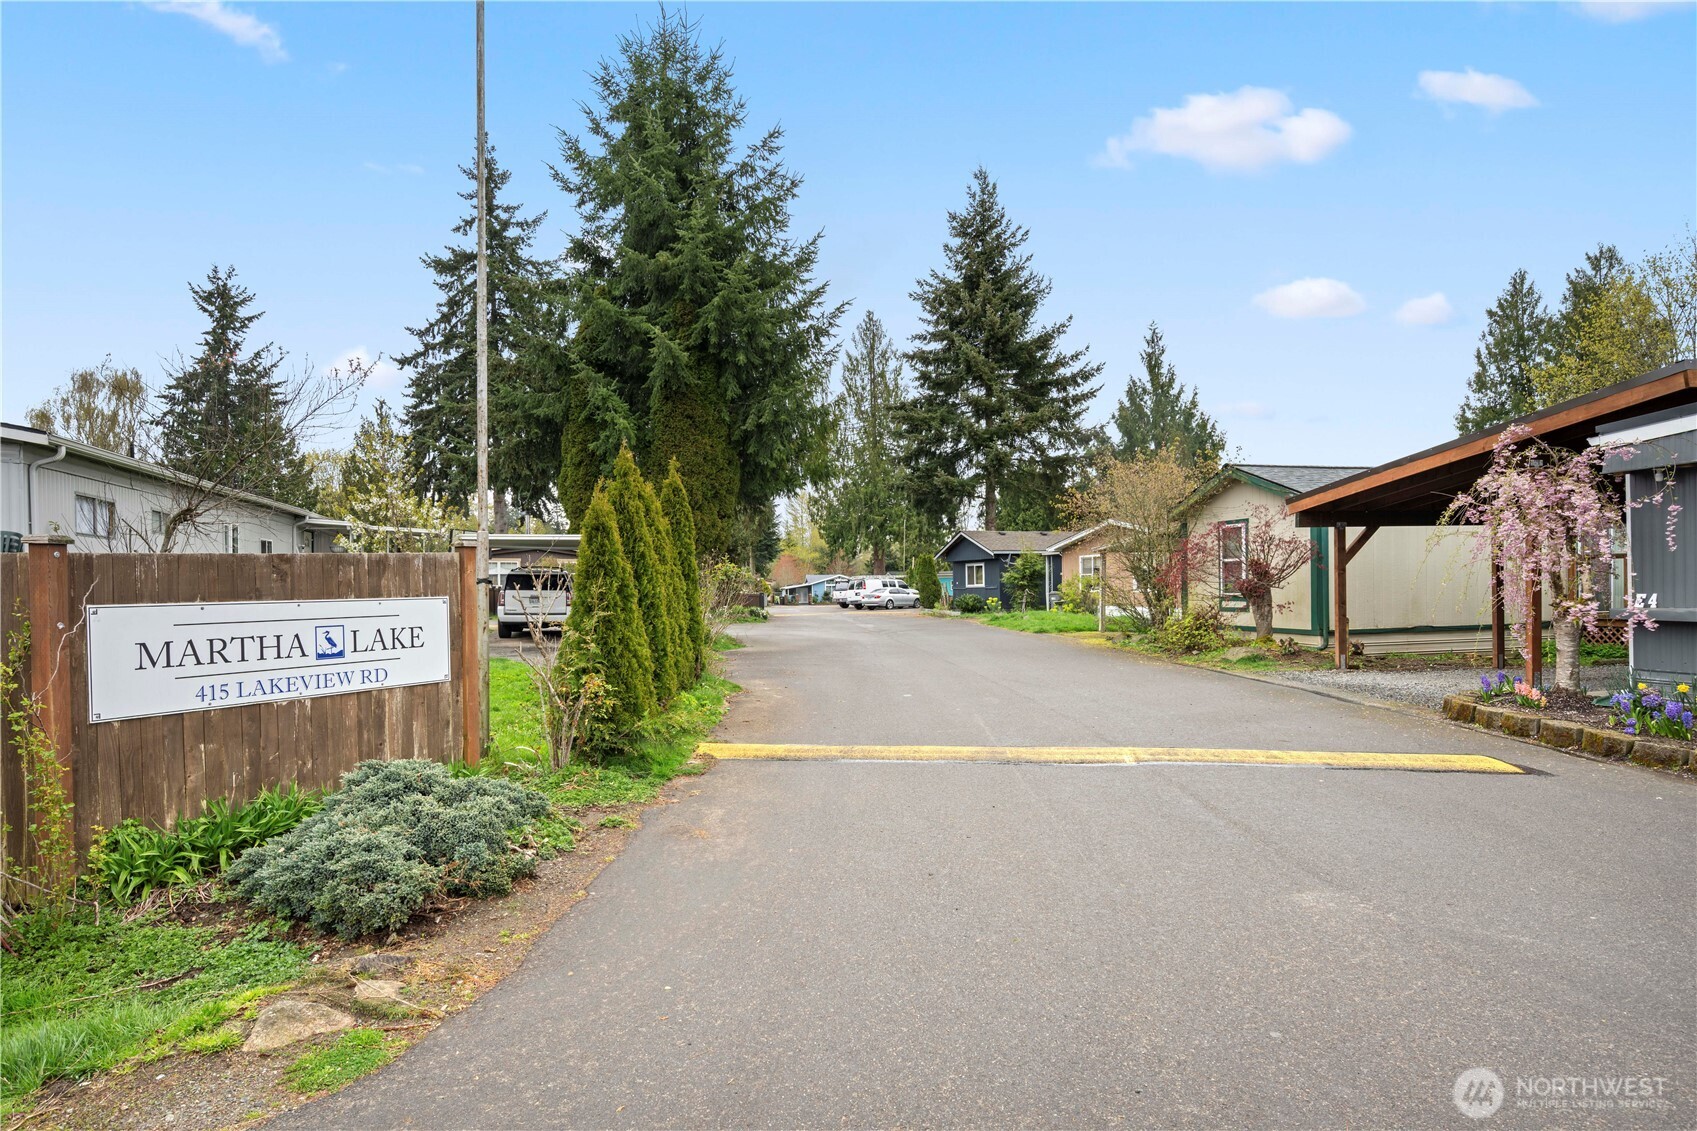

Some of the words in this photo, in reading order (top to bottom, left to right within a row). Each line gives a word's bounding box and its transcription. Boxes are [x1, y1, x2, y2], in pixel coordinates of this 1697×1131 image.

[134, 633, 309, 670] MARTHA
[350, 626, 425, 653] LAKE
[195, 683, 229, 702] 415
[236, 670, 355, 699] LAKEVIEW
[360, 667, 388, 685] RD
